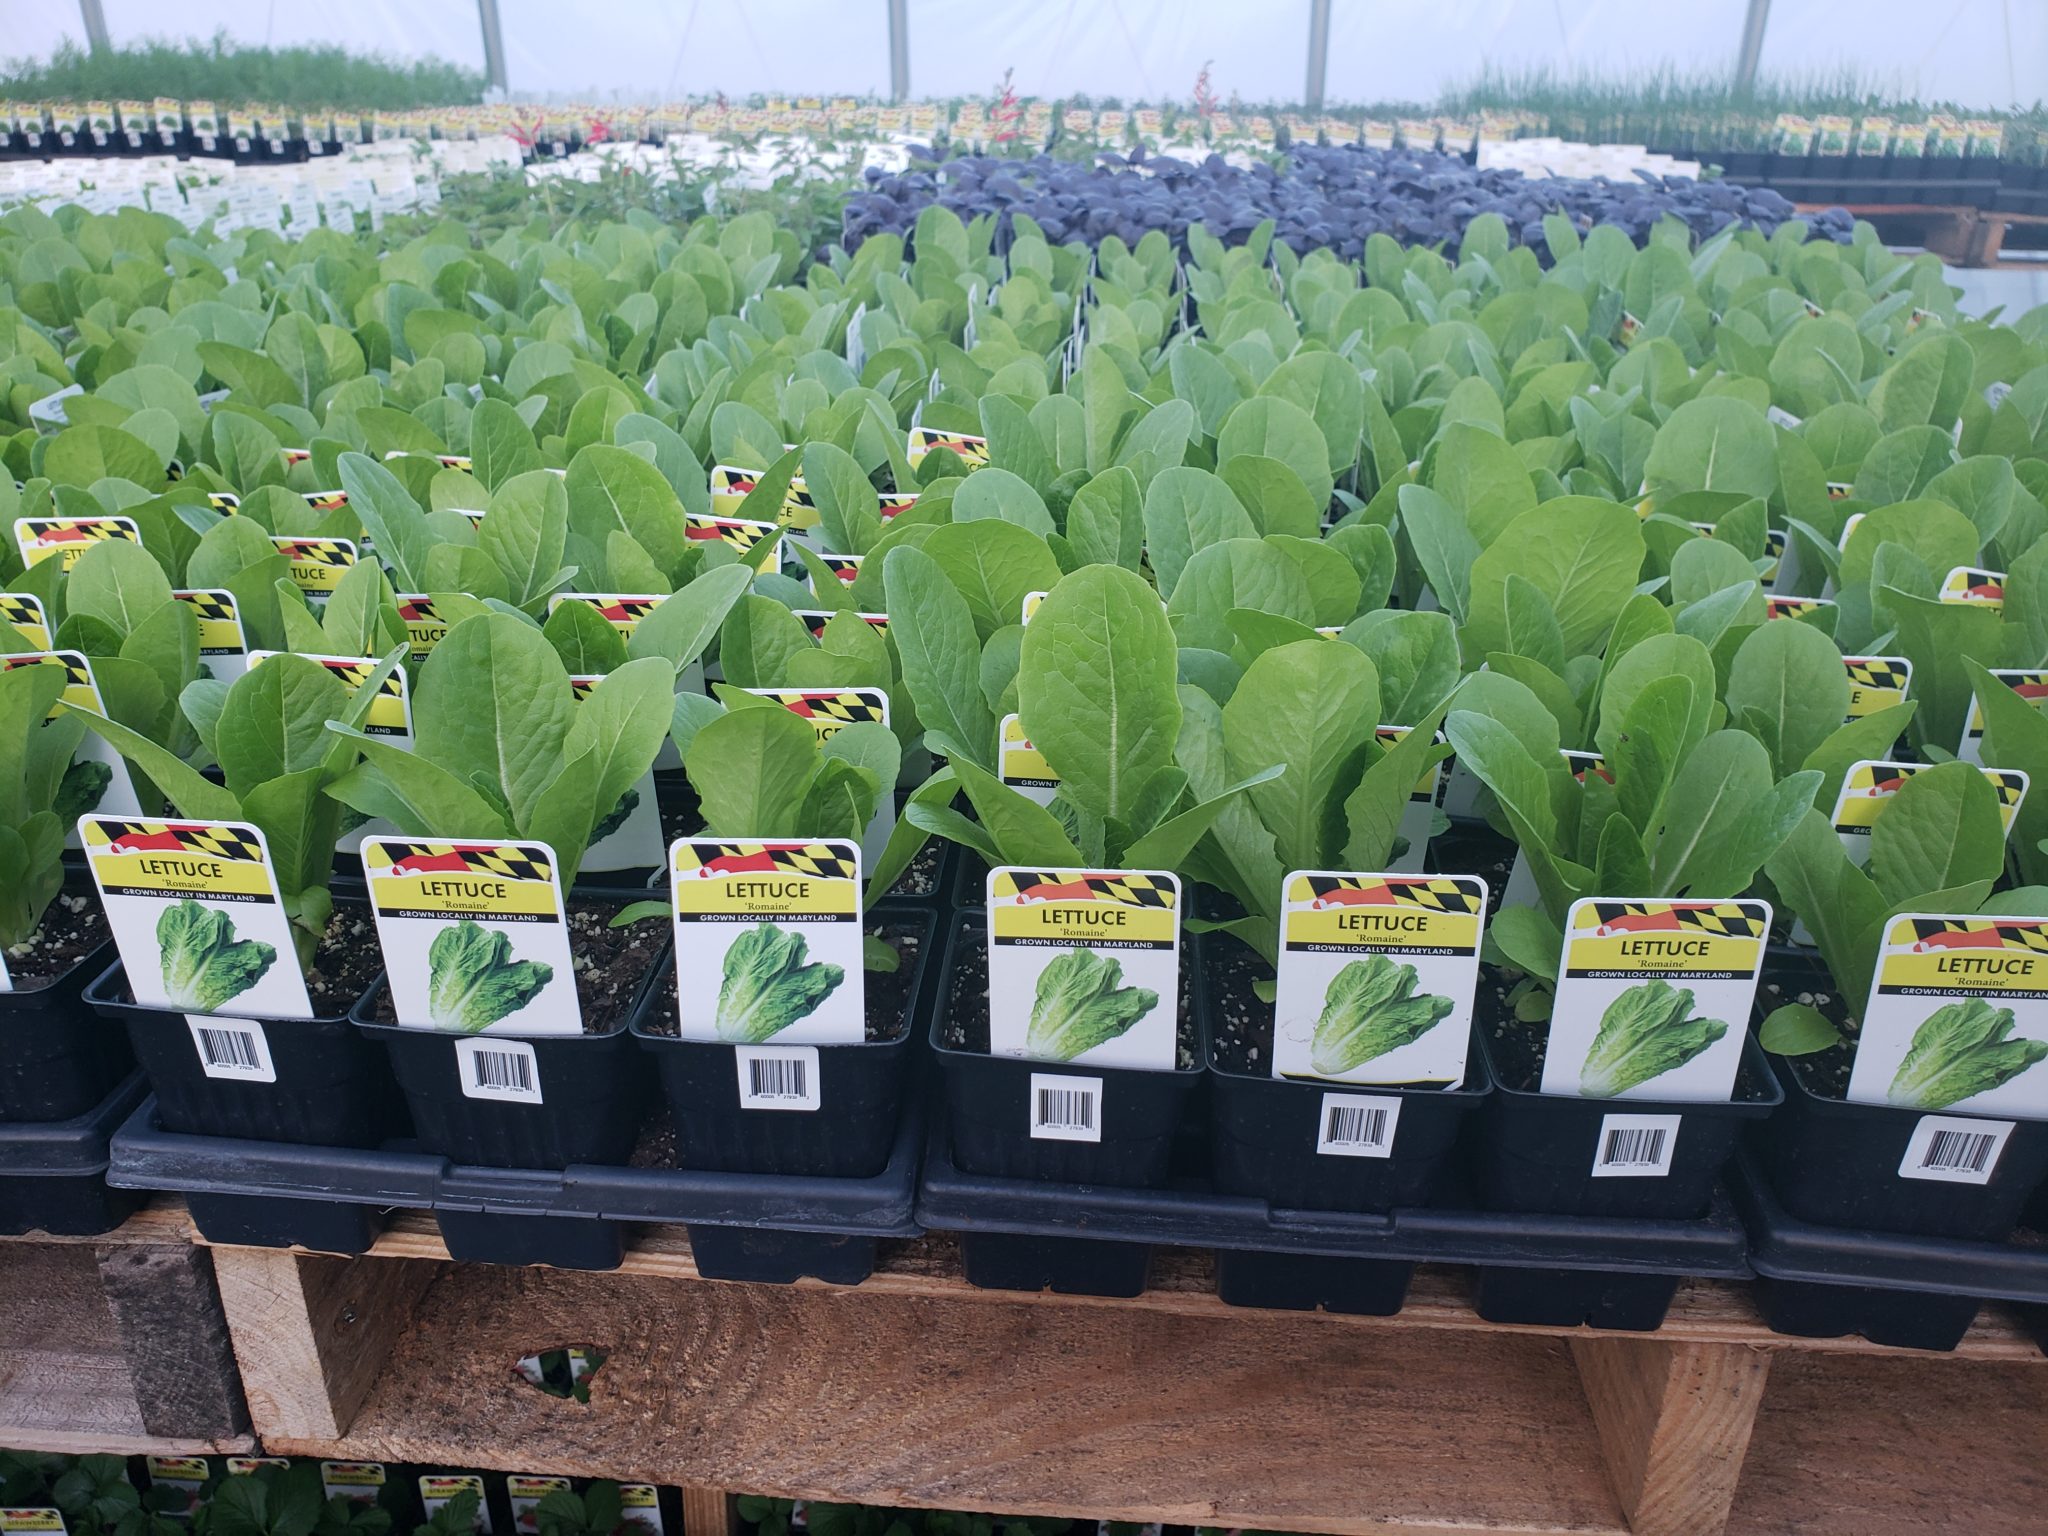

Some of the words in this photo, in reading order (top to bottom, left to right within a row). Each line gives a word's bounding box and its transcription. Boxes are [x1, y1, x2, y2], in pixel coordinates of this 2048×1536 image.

[291, 567, 327, 580] TUCE
[366, 726, 391, 734] YLAND
[139, 859, 224, 878] LETTUCE
[122, 887, 158, 897] GROWN
[157, 889, 195, 900] LOCALLY
[195, 891, 207, 900] IN
[207, 892, 256, 903] MARYLAND
[420, 880, 507, 899] LETTUCE
[726, 882, 811, 899] LETTUCE
[398, 909, 436, 919] GROWN
[436, 911, 475, 921] LOCALLY
[475, 912, 487, 921] IN
[487, 913, 539, 922] MARYLAND
[699, 913, 737, 922] GROWN
[737, 913, 775, 922] LOCALLY
[775, 914, 787, 922] IN
[787, 913, 838, 922] MARYLAND
[1041, 908, 1127, 927] LETTUCE
[1337, 913, 1429, 933] LETTUCE
[1014, 937, 1052, 947] GROWN
[1052, 938, 1090, 948] LOCALLY
[1090, 939, 1102, 948] IN
[1102, 940, 1154, 950] MARYLAND
[1306, 943, 1347, 953] GROWN
[1346, 944, 1387, 954] LOCALLY
[1387, 946, 1400, 955] IN
[1400, 946, 1454, 956] MARYLAND
[1619, 940, 1712, 957] LETTUCE
[1936, 957, 2036, 976] LETTUCE
[1586, 970, 1626, 979] GROWN
[1626, 970, 1666, 980] LOCALLY
[1666, 971, 1679, 979] IN
[1679, 971, 1733, 980] MARYLAND
[1899, 986, 1942, 997] GROWN
[1942, 987, 1985, 998] LOCALLY
[1985, 989, 1999, 998] IN
[2000, 990, 2048, 999] MARYLAN
